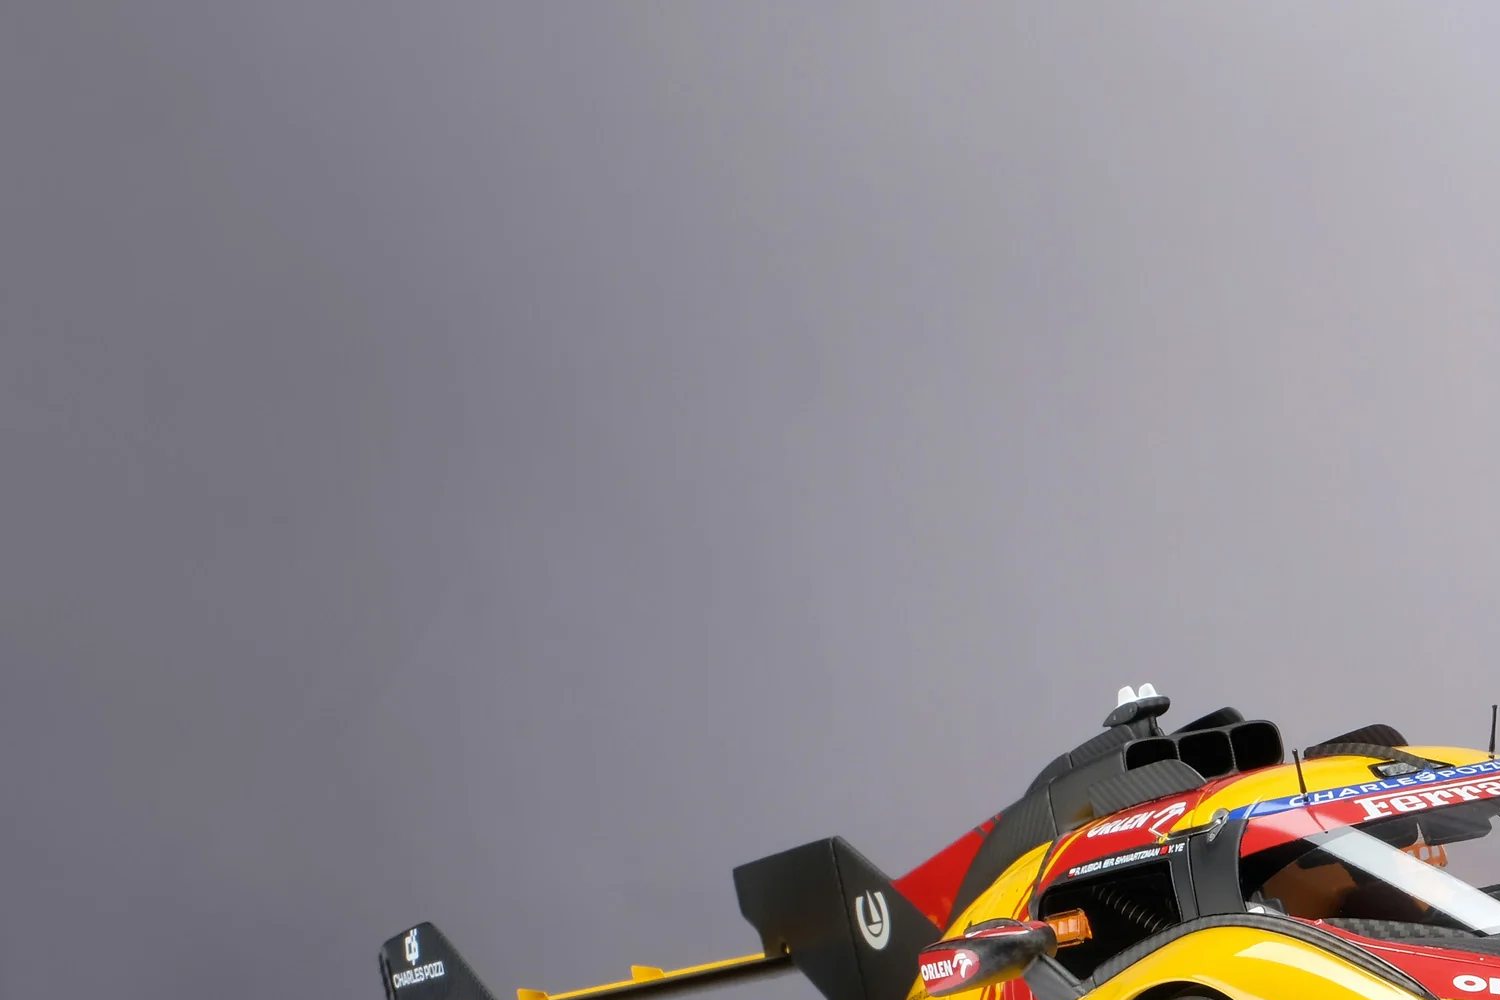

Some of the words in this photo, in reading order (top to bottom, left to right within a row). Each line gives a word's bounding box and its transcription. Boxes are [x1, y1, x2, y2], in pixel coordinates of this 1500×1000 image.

[1289, 771, 1437, 807] CHARLES
[1087, 811, 1155, 838] ORLEN
[393, 967, 424, 988] CHARLES
[424, 961, 445, 979] POZZI
[921, 959, 953, 981] ORLEN
